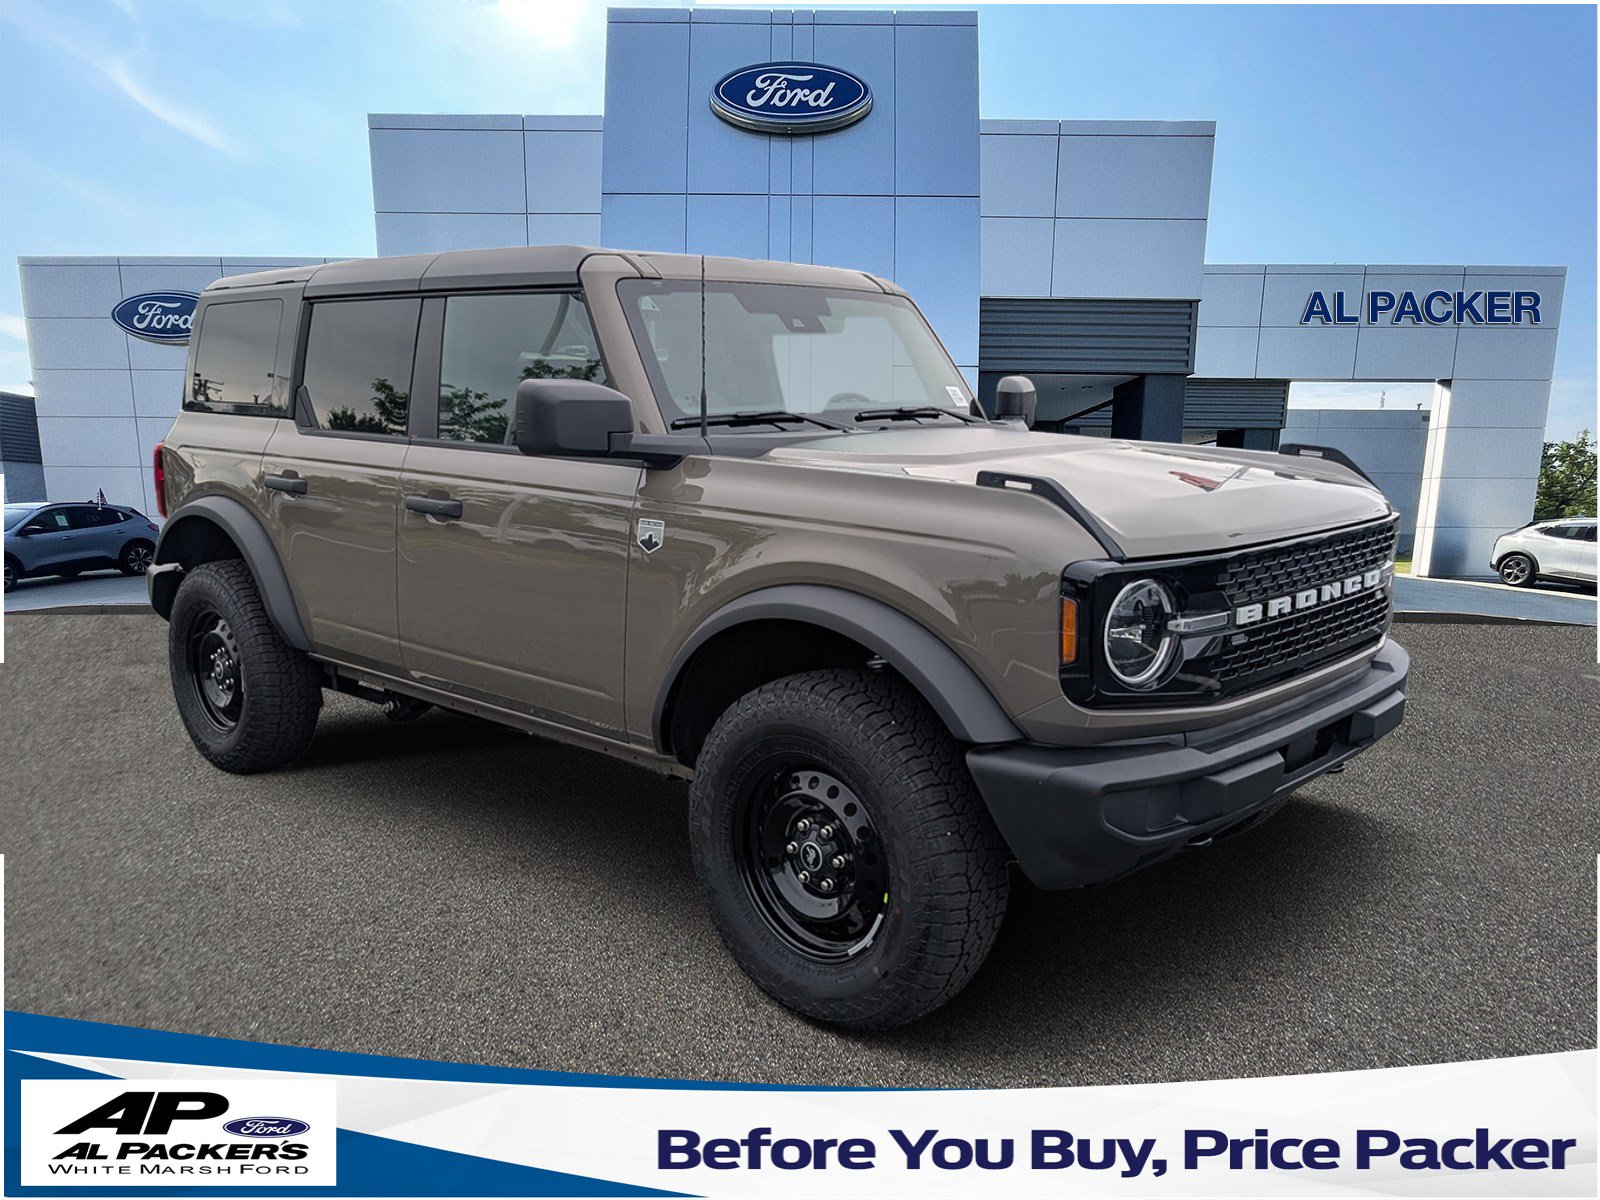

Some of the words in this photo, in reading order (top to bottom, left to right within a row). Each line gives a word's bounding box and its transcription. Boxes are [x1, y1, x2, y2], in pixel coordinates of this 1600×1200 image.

[746, 73, 836, 107] Ford
[133, 301, 197, 329] Ford
[1302, 291, 1359, 323] AL
[1369, 290, 1542, 323] PACKER
[1236, 569, 1381, 626] BRONCO
